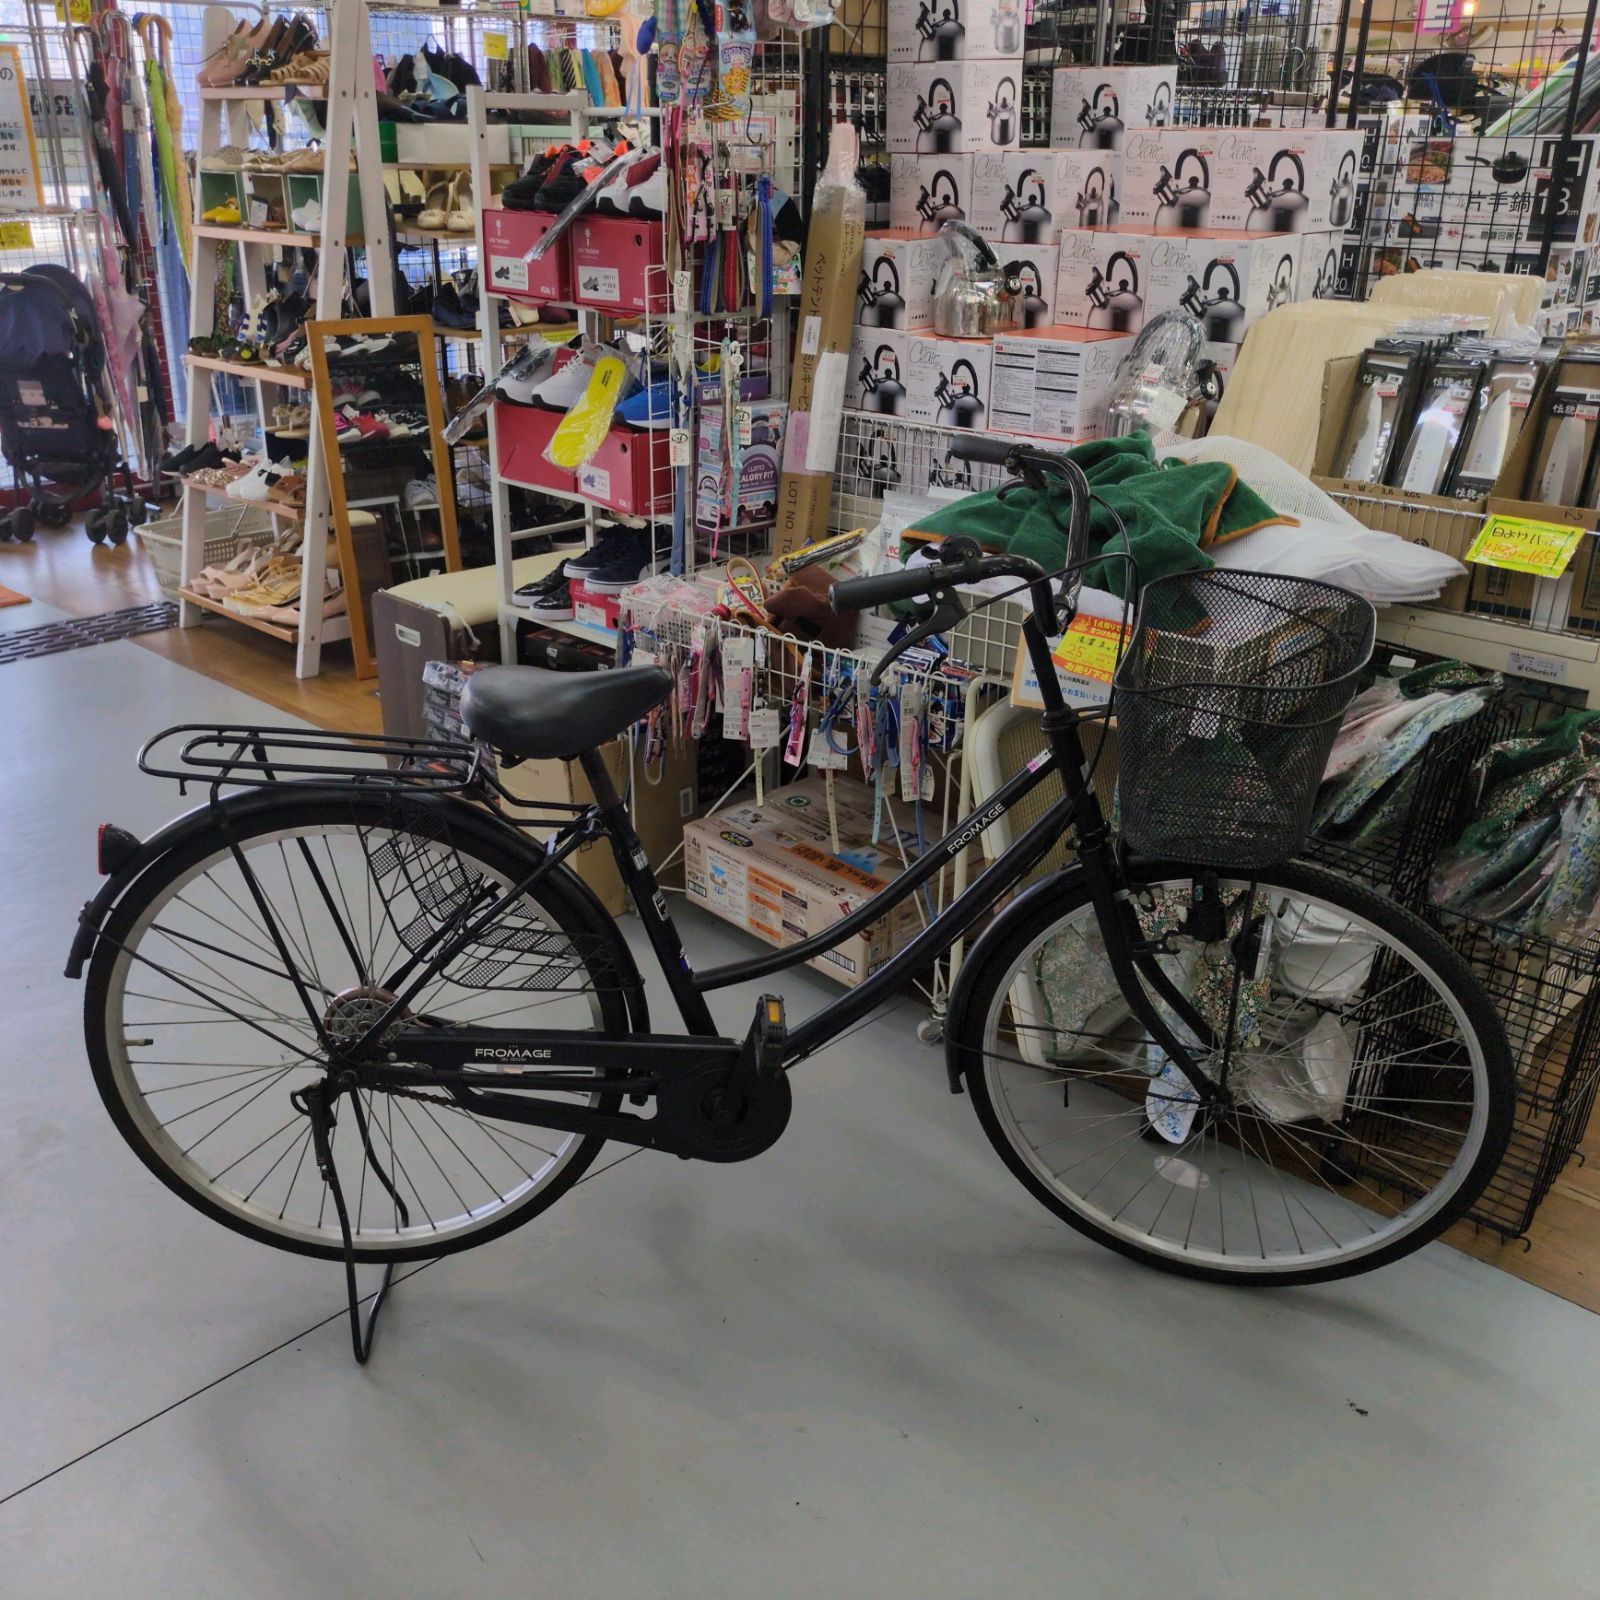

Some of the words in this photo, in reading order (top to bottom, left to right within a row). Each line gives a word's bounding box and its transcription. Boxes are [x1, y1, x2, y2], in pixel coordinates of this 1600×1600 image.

[1151, 241, 1191, 267] Clair
[787, 480, 800, 508] LOT
[947, 803, 1006, 854] FROMAGE
[474, 1048, 552, 1059] FROMAGE
